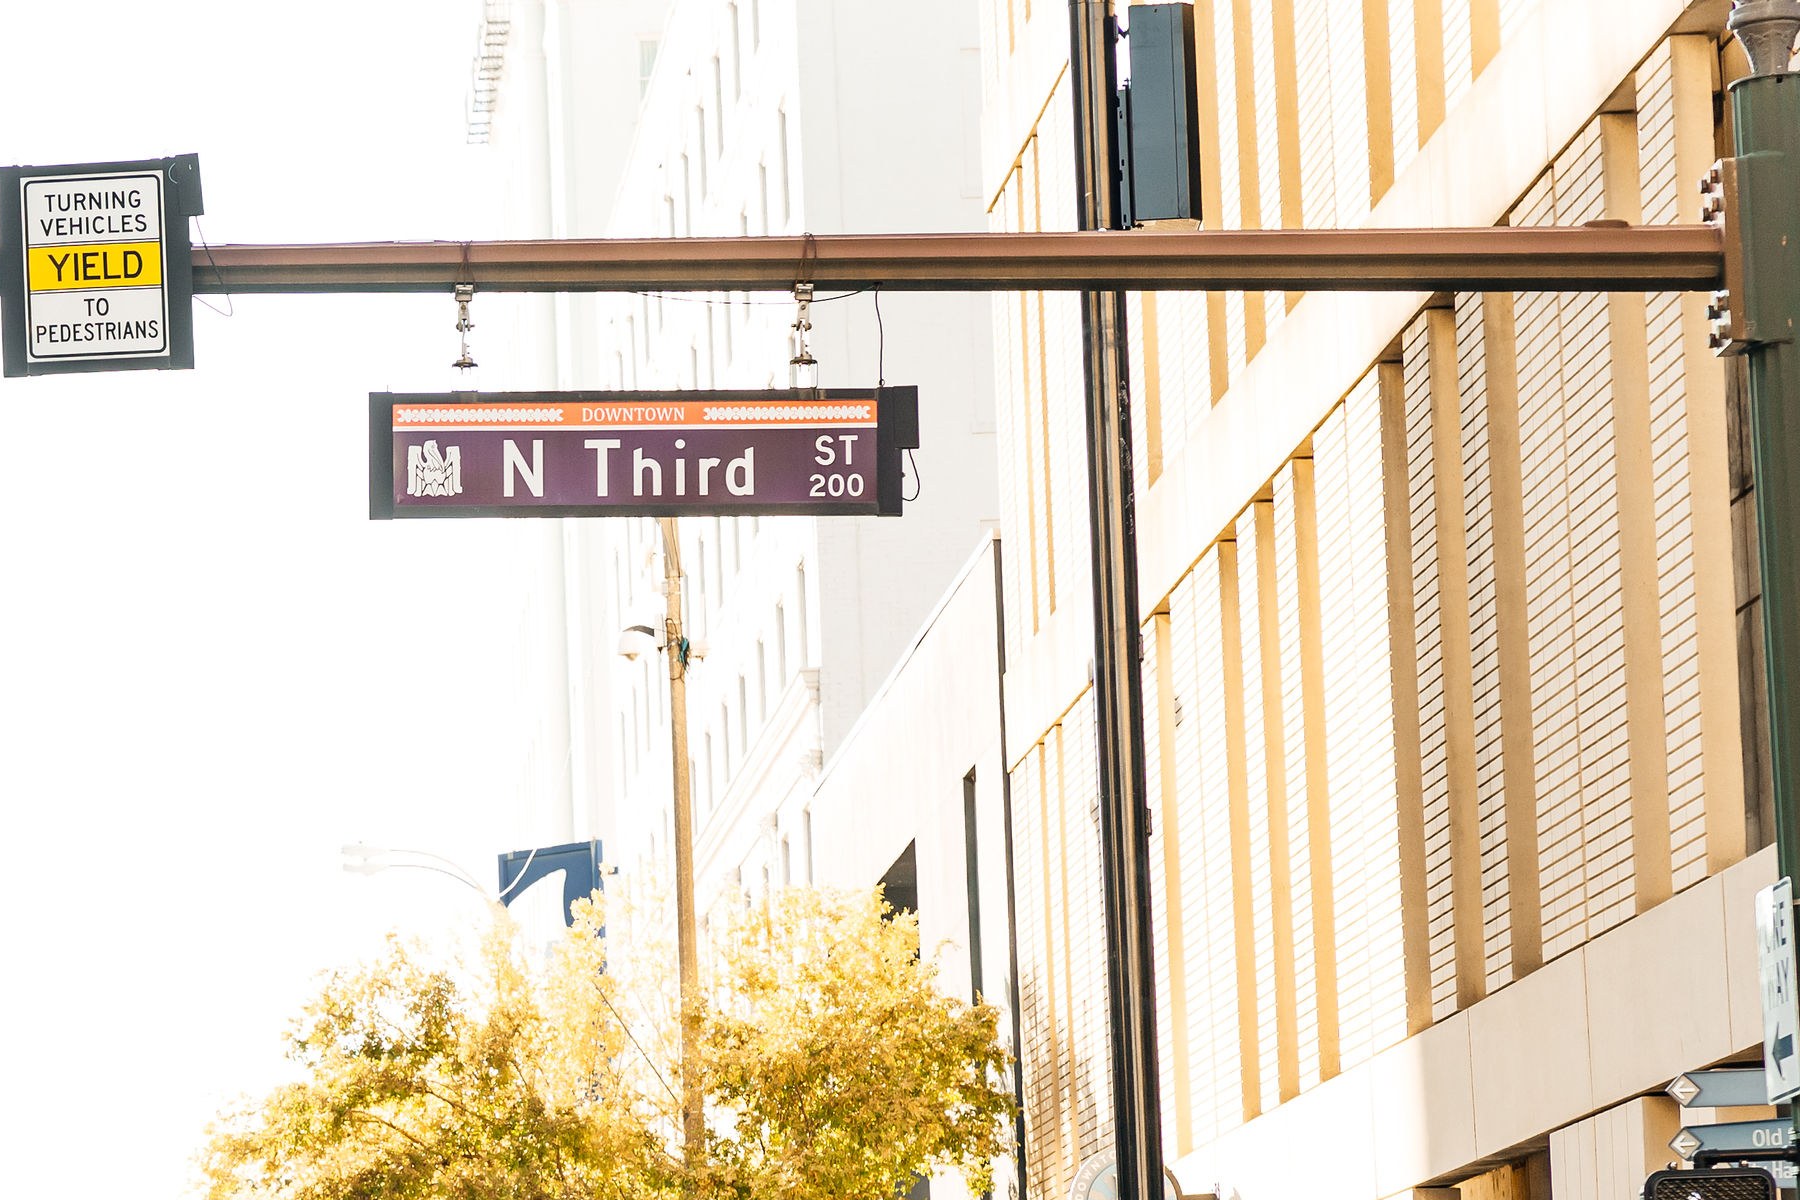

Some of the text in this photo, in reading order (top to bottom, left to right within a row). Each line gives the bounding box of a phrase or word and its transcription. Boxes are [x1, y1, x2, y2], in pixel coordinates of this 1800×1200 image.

[44, 190, 142, 212] TURNING
[40, 214, 147, 236] VEHICLES
[48, 251, 143, 282] YIELD
[83, 298, 109, 316] TO
[36, 320, 158, 343] PEDESTRIANS
[581, 406, 686, 423] DOWNTOWN
[503, 434, 859, 497] N Third ST
[808, 474, 865, 497] 200
[1752, 1128, 1783, 1147] Old
